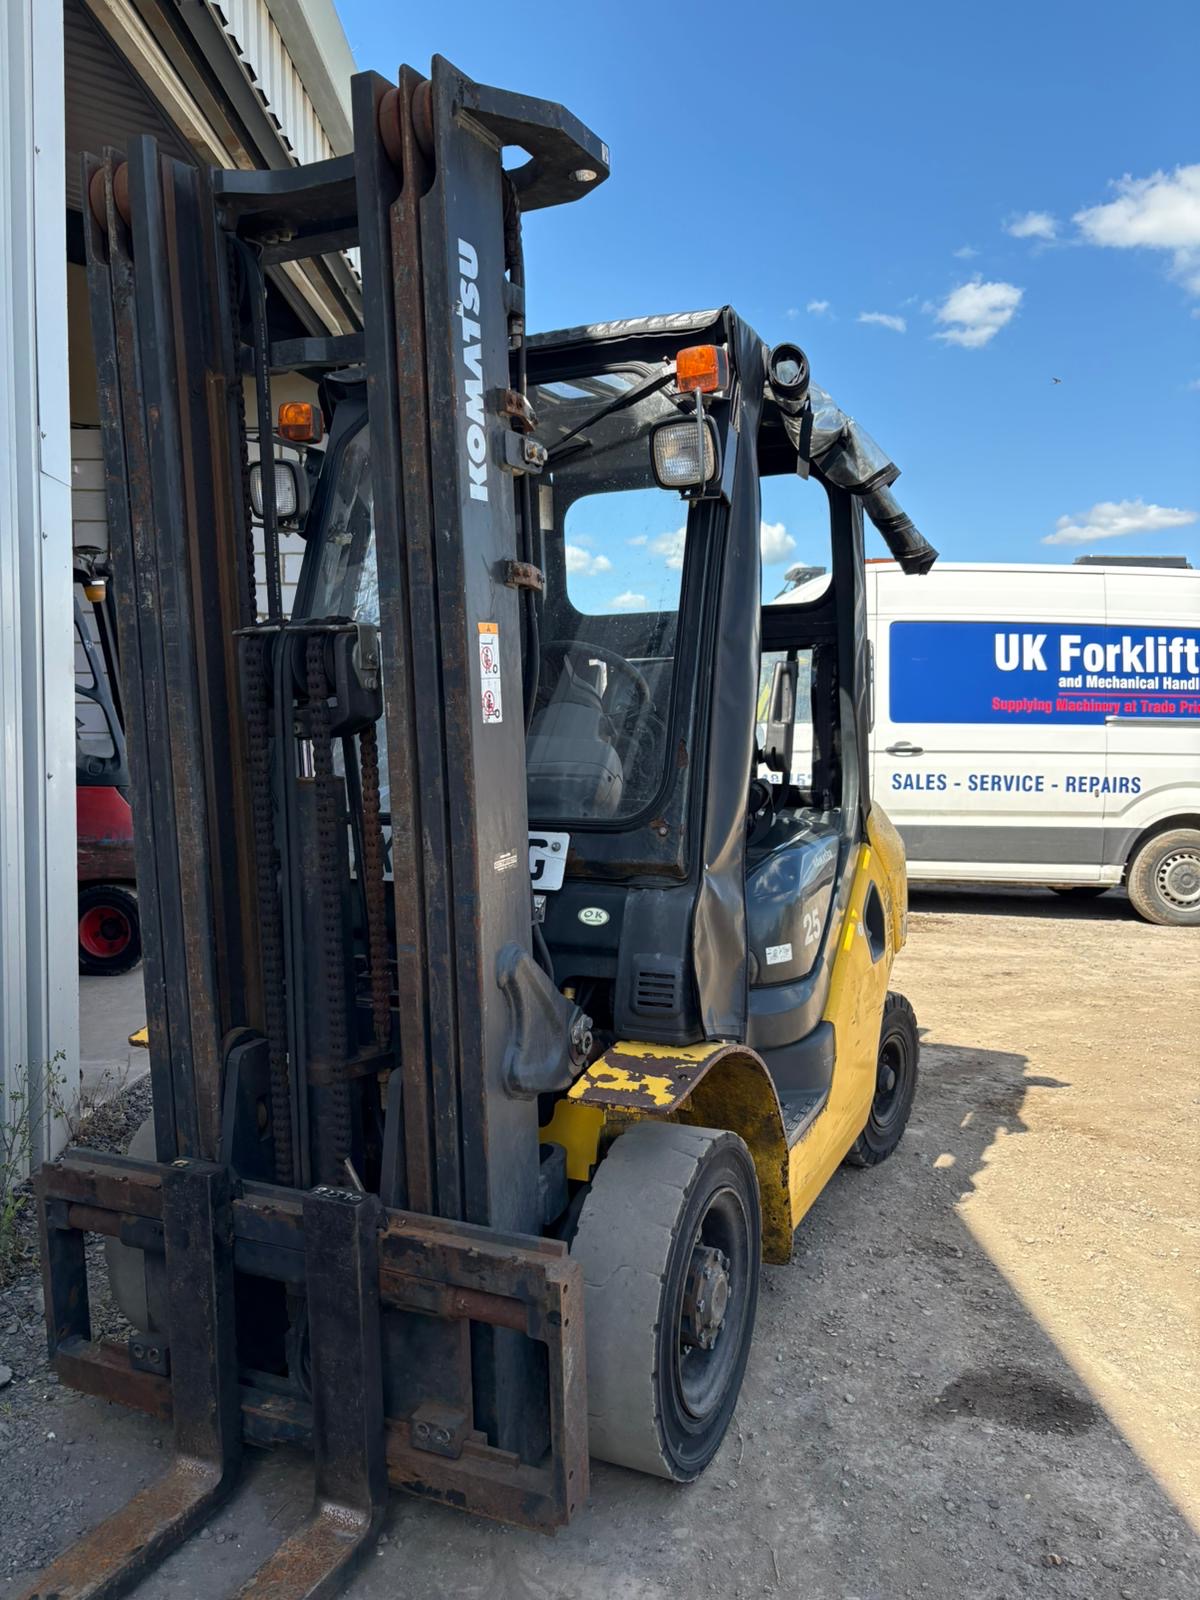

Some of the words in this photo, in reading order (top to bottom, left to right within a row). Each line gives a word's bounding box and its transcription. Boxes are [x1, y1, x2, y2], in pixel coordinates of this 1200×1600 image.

[457, 237, 488, 502] KOMATSU
[995, 633, 1048, 671] UK
[1060, 634, 1199, 674] Forklift
[1058, 675, 1083, 688] and
[1086, 675, 1159, 690] Mechanical
[992, 697, 1052, 714] Supplying
[1056, 698, 1120, 715] Machinery
[1124, 700, 1136, 713] at
[1140, 700, 1176, 714] Trade
[892, 773, 947, 791] SALES
[968, 774, 1044, 792] SERVICE
[1066, 776, 1141, 794] REPAIRS
[803, 908, 821, 946] 25
